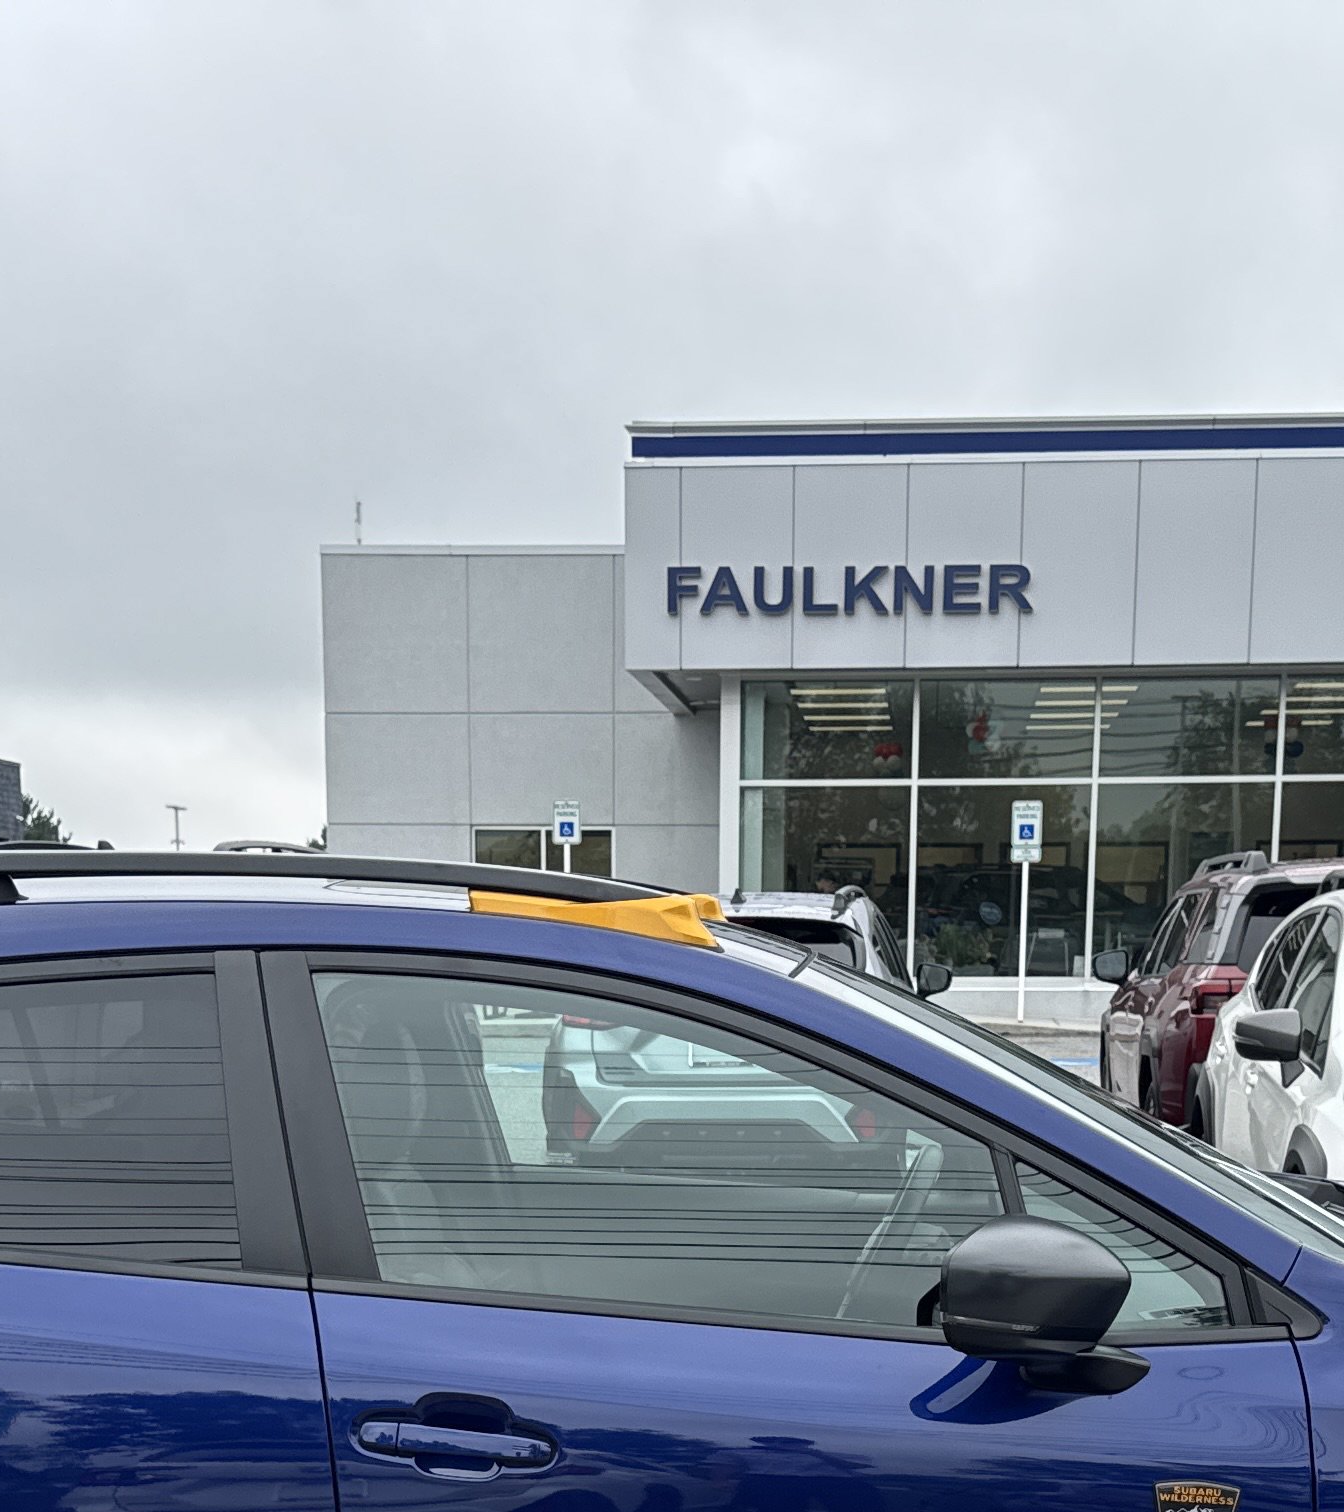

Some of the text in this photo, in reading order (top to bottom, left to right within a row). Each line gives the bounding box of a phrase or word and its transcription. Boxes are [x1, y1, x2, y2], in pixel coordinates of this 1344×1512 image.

[667, 564, 1034, 616] FAULKNER
[1173, 1486, 1222, 1496] SUBARU
[1159, 1493, 1234, 1505] WILDERNESS
